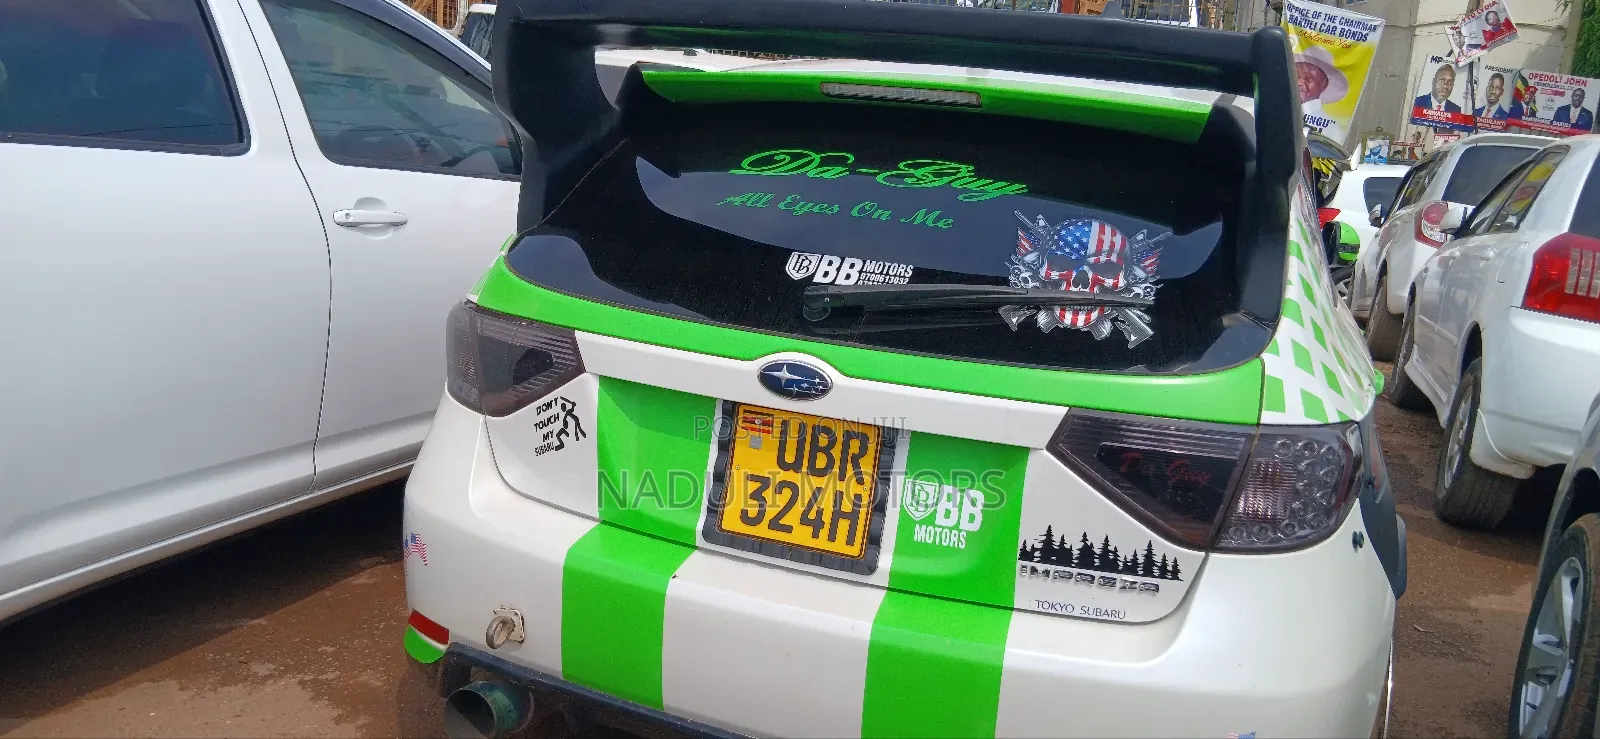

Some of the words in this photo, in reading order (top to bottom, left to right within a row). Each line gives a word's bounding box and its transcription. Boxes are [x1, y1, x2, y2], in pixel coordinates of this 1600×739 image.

[1286, 3, 1310, 18] OFFICE
[1311, 10, 1322, 20] OF
[1323, 13, 1337, 25] THE
[1338, 17, 1378, 33] CHAIRMAN
[1287, 14, 1318, 31] BAKULI
[1318, 22, 1337, 36] CAR
[1338, 27, 1369, 42] BONDS
[1430, 55, 1443, 64] MP
[1484, 64, 1514, 75] PRESIDENT
[1528, 72, 1562, 84] OPEDOLI
[1564, 77, 1588, 88] JOHN
[716, 192, 775, 208] All
[777, 194, 840, 216] Eyes
[850, 200, 892, 221] On
[899, 208, 954, 229] Me
[813, 254, 864, 286] BB
[862, 259, 914, 278] MOTORS
[534, 412, 560, 432] TOUCH
[534, 442, 555, 457] SUBARU
[542, 429, 554, 443] MY
[776, 419, 870, 486] UBR
[739, 474, 863, 546] 324H
[934, 484, 985, 532] BB
[913, 523, 967, 549] MOTORS
[1020, 564, 1160, 594] IMPREZA
[1035, 599, 1075, 614] TOKYO
[1080, 605, 1126, 620] SUBARU
